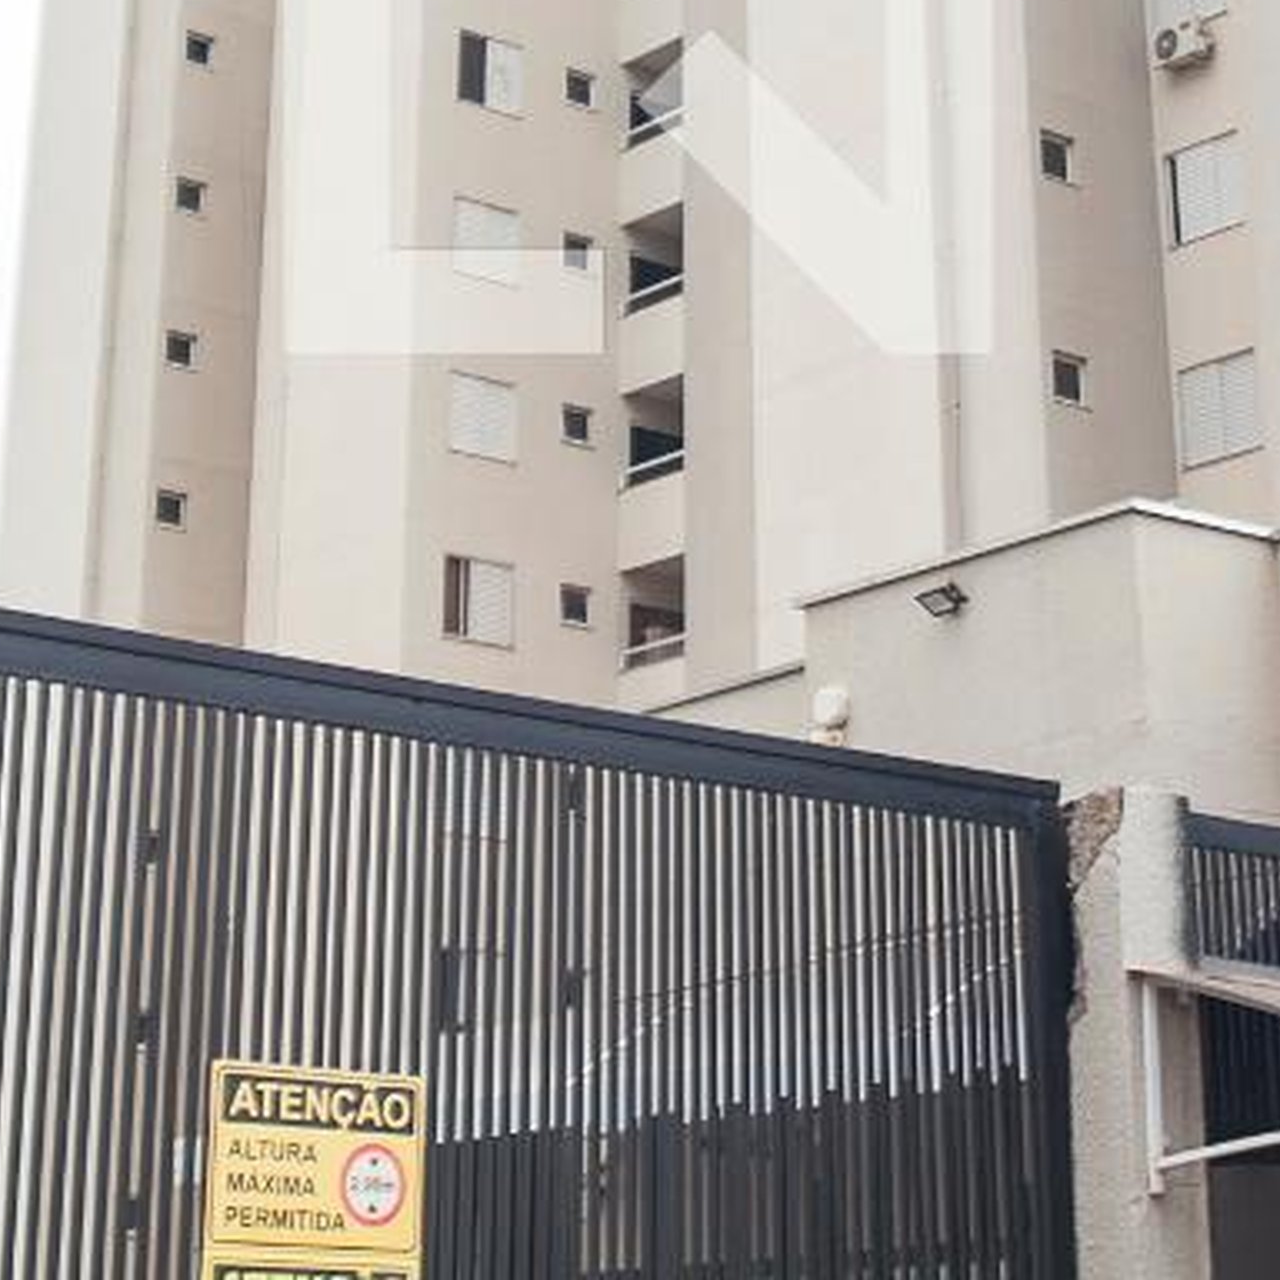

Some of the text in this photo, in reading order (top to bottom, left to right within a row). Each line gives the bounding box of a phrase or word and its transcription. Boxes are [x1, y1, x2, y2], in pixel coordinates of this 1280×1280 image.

[228, 1077, 411, 1131] ATENÇÃO
[228, 1139, 319, 1164] ALTURA
[224, 1205, 347, 1232] PERMITIDA
